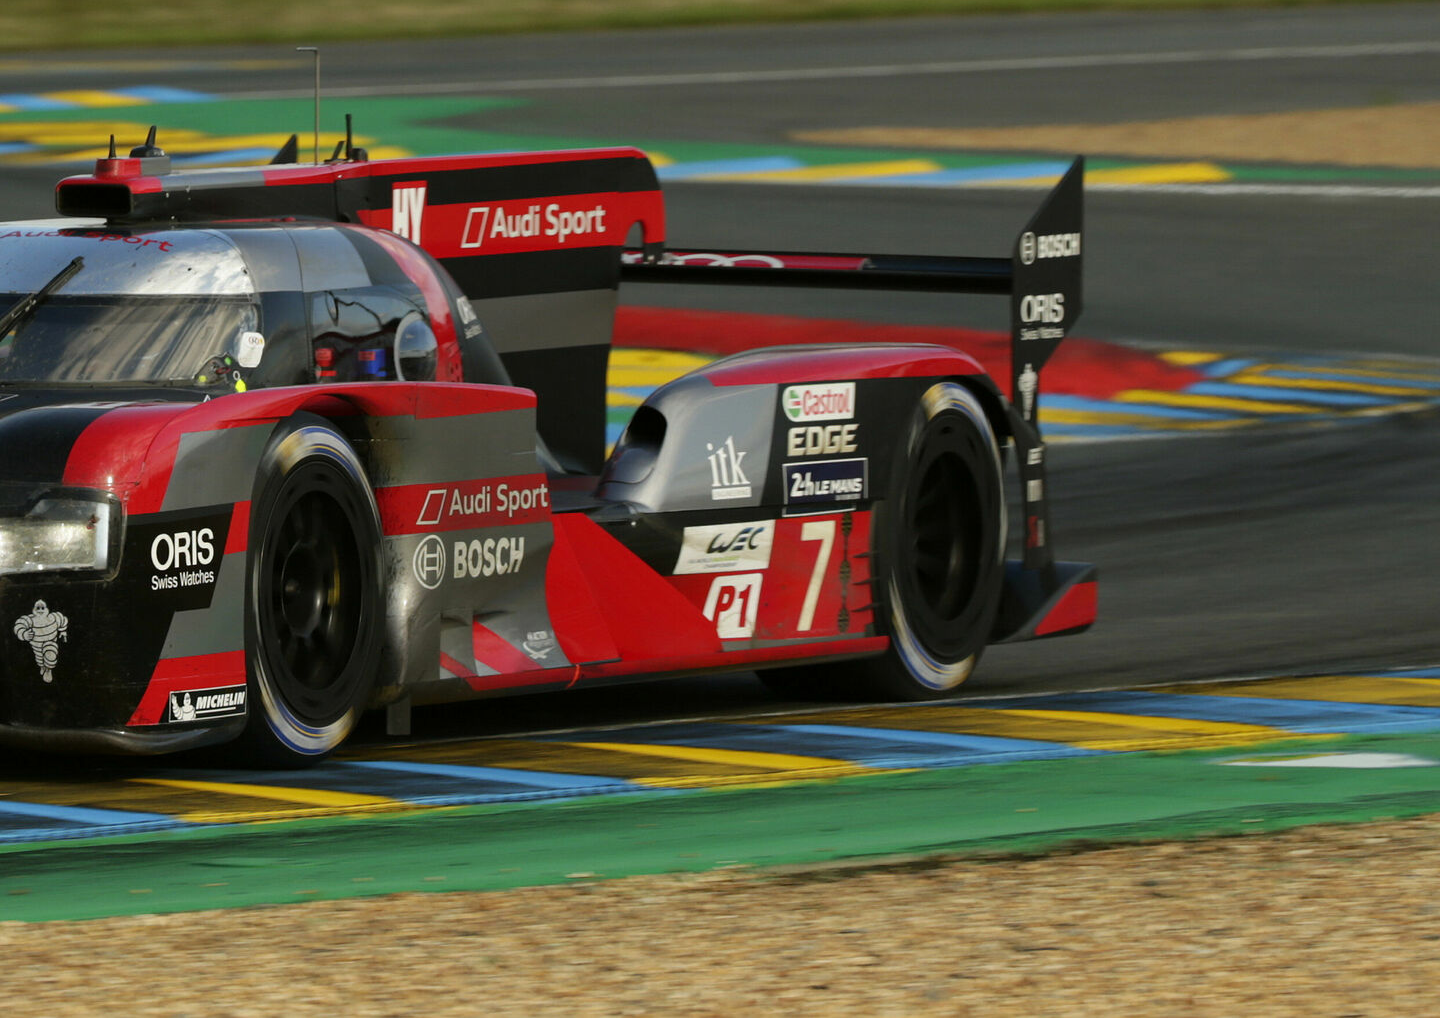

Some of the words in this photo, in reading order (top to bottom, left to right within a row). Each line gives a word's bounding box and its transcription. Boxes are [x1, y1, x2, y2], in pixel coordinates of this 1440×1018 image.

[391, 186, 427, 246] HY
[489, 204, 542, 239] Audi
[544, 203, 607, 244] Sport
[80, 231, 174, 252] Sport
[1037, 232, 1081, 259] BOSCH
[1020, 292, 1065, 323] ORIS
[802, 387, 851, 416] Castrol
[787, 423, 860, 457] EDGE
[706, 435, 752, 487] itk
[448, 485, 491, 517] Audi
[496, 483, 549, 518] Sport
[150, 527, 215, 571] ORIS
[706, 526, 765, 554] WEC
[453, 536, 525, 579] BOSCH
[151, 574, 178, 591] Swiss
[179, 569, 215, 587] Watches
[796, 520, 837, 632] 7
[712, 583, 753, 628] P1
[195, 691, 246, 710] MICHELIN
